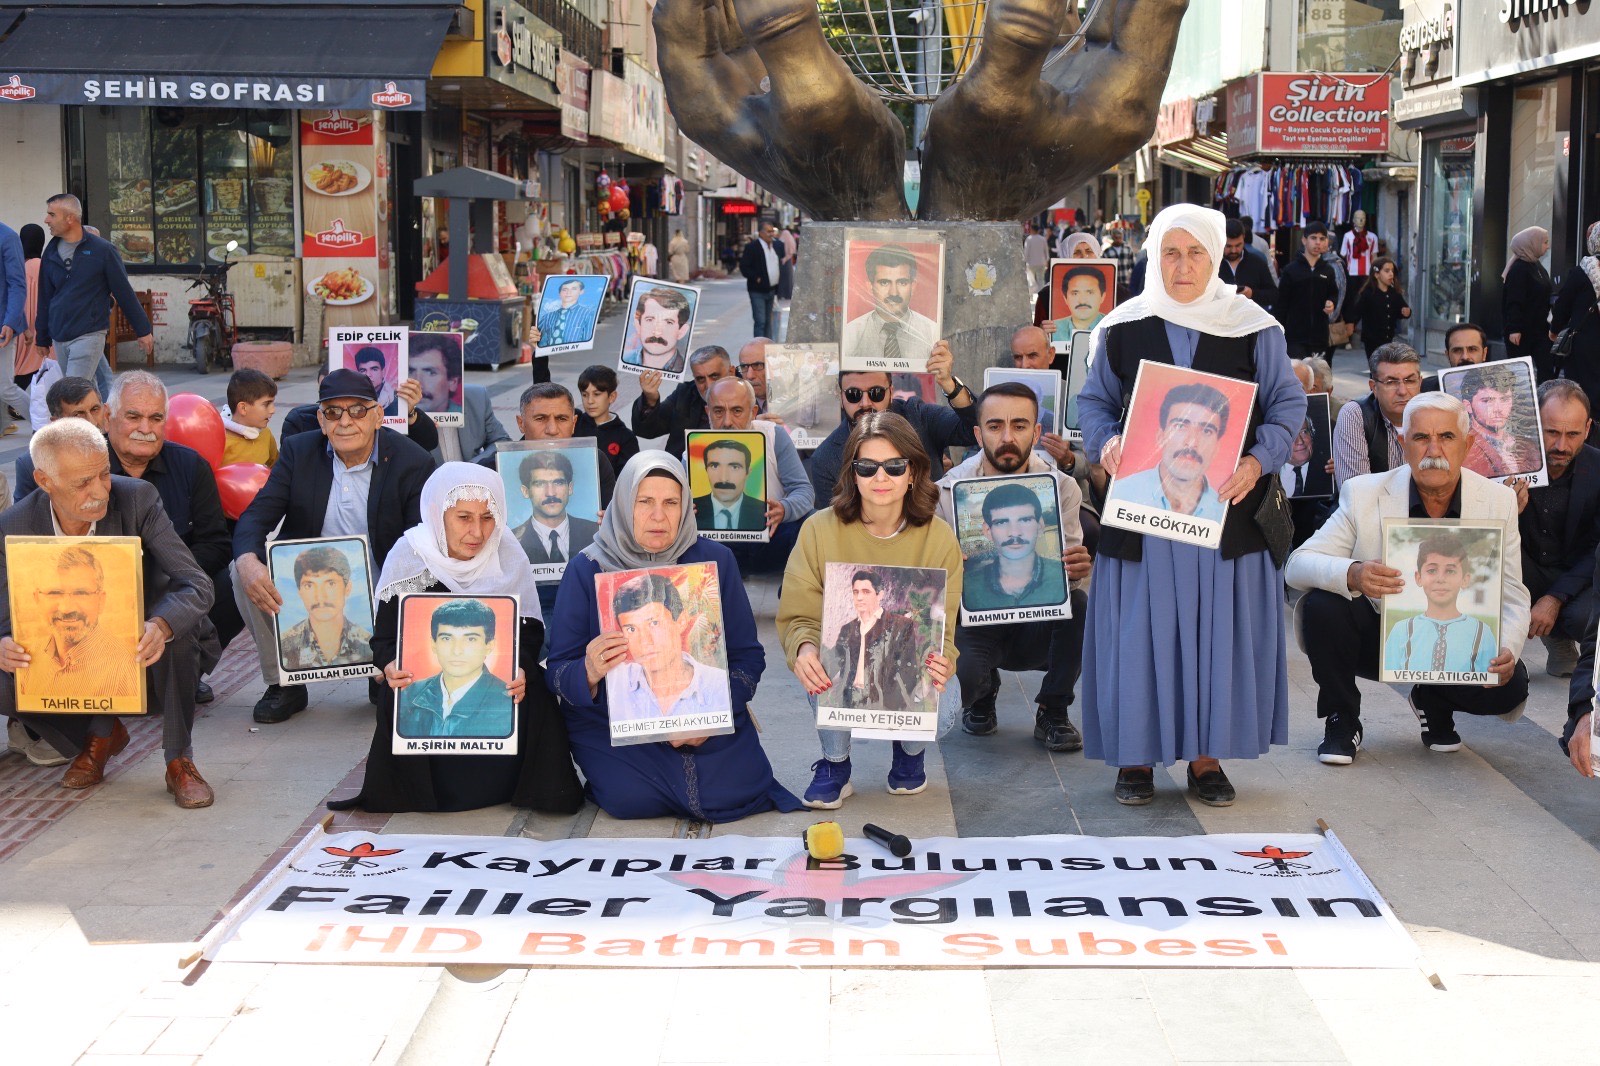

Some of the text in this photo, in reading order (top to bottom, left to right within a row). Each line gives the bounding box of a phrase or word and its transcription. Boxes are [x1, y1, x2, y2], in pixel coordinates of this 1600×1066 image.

[1, 87, 31, 97] şenpiliç
[84, 77, 325, 102] ŞEHİR SOFRASI
[1286, 79, 1365, 107] Şirin
[376, 92, 407, 103] şenpiliç
[1269, 105, 1381, 123] Collection
[318, 119, 354, 131] şenpiliç
[1269, 126, 1282, 134] Bay
[1310, 126, 1331, 134] Çocuk
[1361, 126, 1381, 135] Giyim
[1282, 135, 1297, 143] Tayt
[322, 232, 357, 244] şenpiliç
[336, 331, 402, 343] EDİP ÇELİK
[866, 360, 910, 369] HASAN KAYA
[662, 372, 680, 380] TEPE
[1116, 508, 1210, 539] Eset GÖKTAYI
[720, 532, 763, 540] DEĞİRMENCİ
[968, 609, 1065, 623] MAHMUT DEMİREL
[287, 666, 375, 682] ABDULLAH BULUT
[1393, 670, 1488, 682] VEYSEL ATILGAN
[40, 697, 113, 711] TAHİR ELÇİ
[612, 714, 729, 733] MEHMET ZEKİ AKYILDIZ
[828, 711, 922, 727] Ahmet YETİŞEN
[407, 740, 504, 751] M.ŞİRİN MALTU
[422, 852, 1218, 878] Kayıplar Bulunsun
[266, 885, 1383, 924] Failler Yargılansın
[518, 932, 900, 957] Batman
[942, 931, 1289, 961] Şubesi
